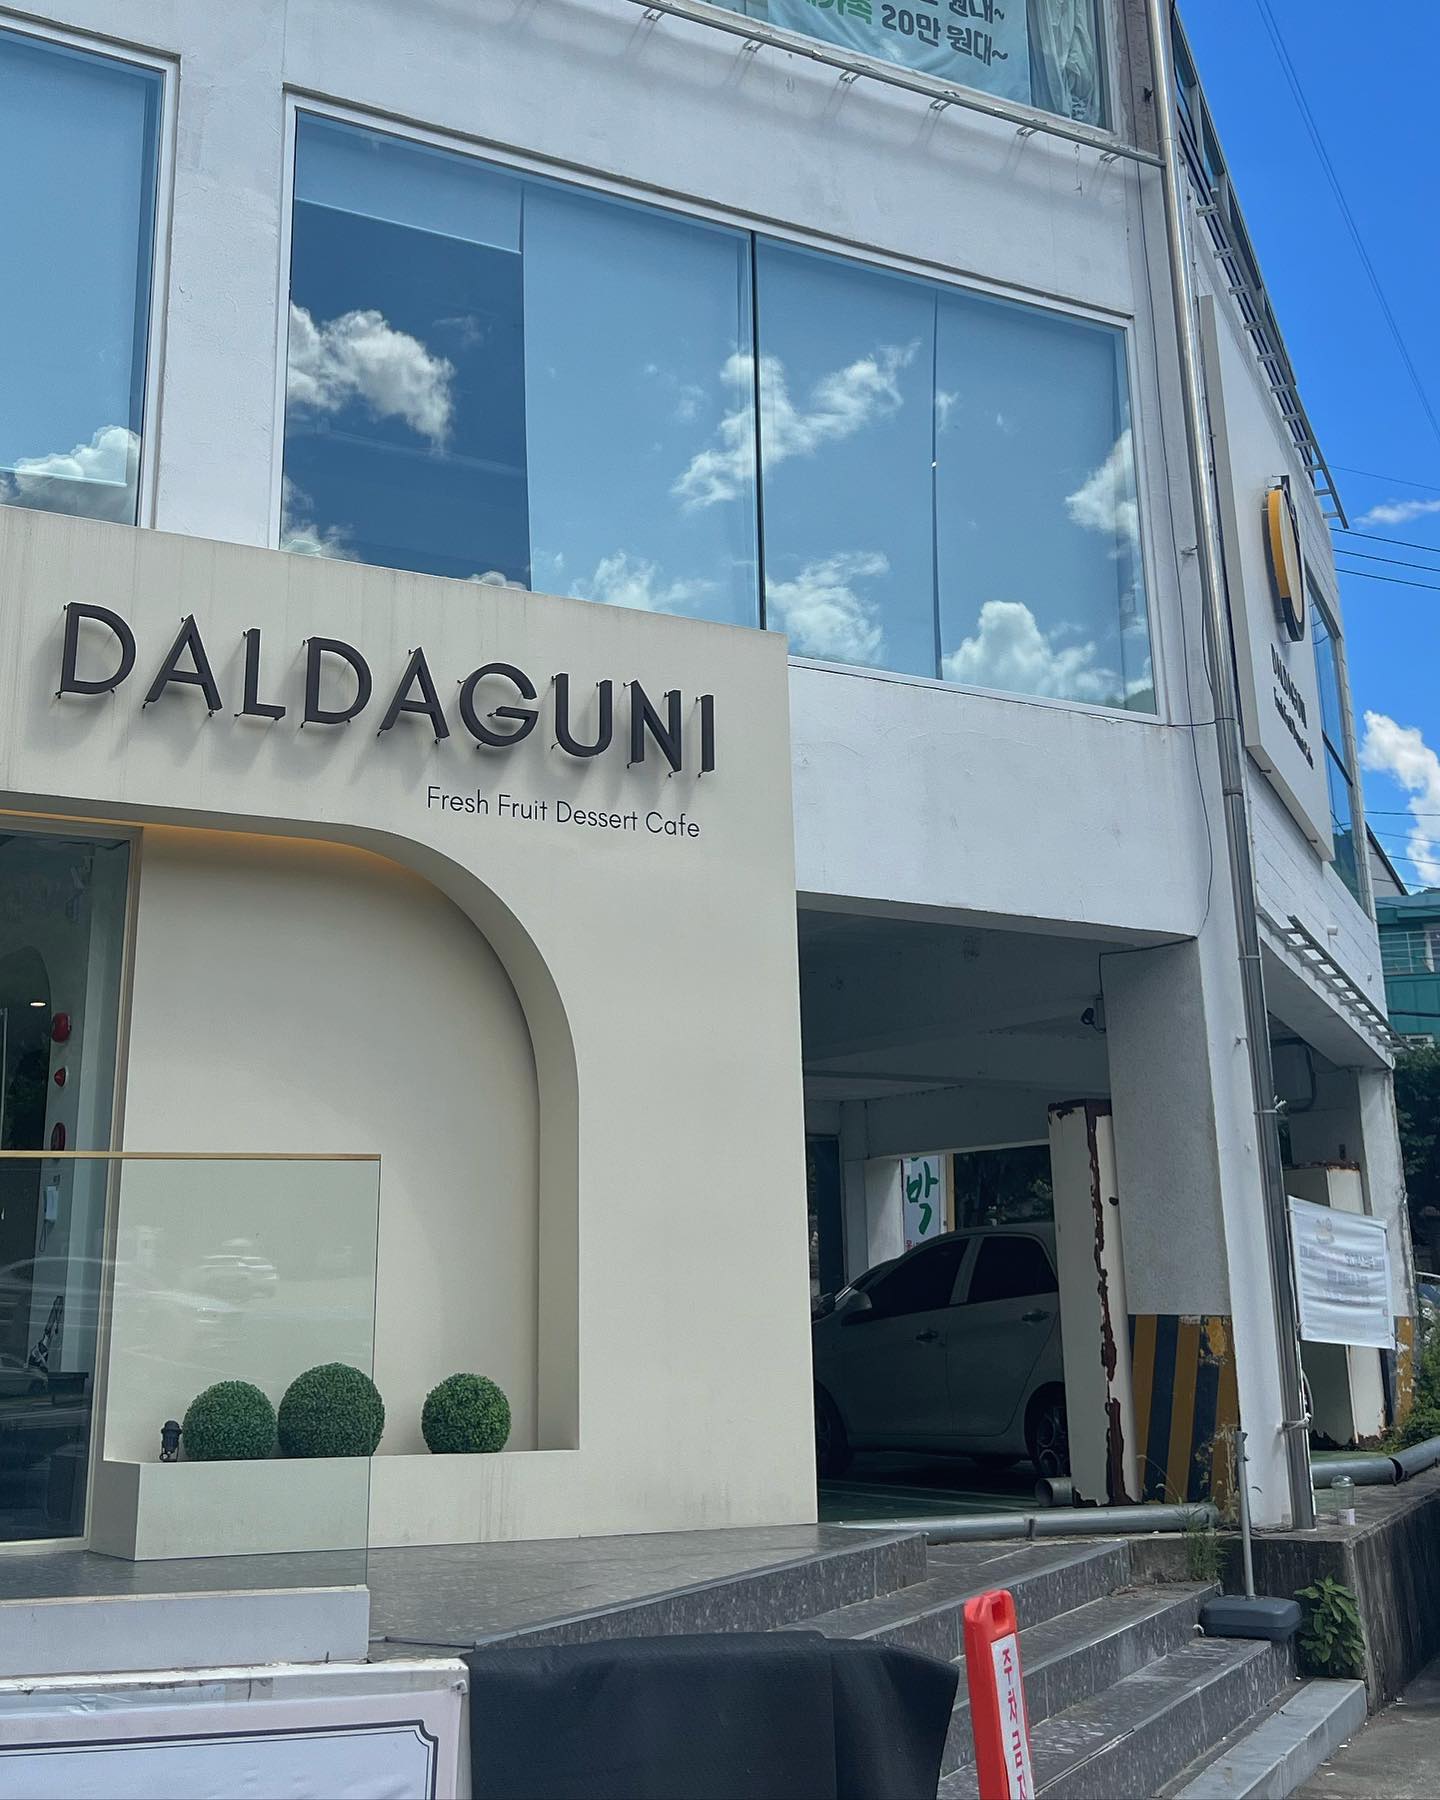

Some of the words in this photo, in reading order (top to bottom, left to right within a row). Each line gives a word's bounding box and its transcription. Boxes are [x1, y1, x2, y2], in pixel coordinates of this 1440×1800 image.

[881, 4, 941, 48] 20만
[946, 24, 1008, 66] 원대~
[60, 601, 715, 773] DALDAGUNI
[427, 786, 489, 814] Fresh
[498, 793, 548, 821] Fruit
[556, 800, 638, 831] Dessert
[645, 811, 701, 838] Cafe
[906, 1157, 939, 1235] 박
